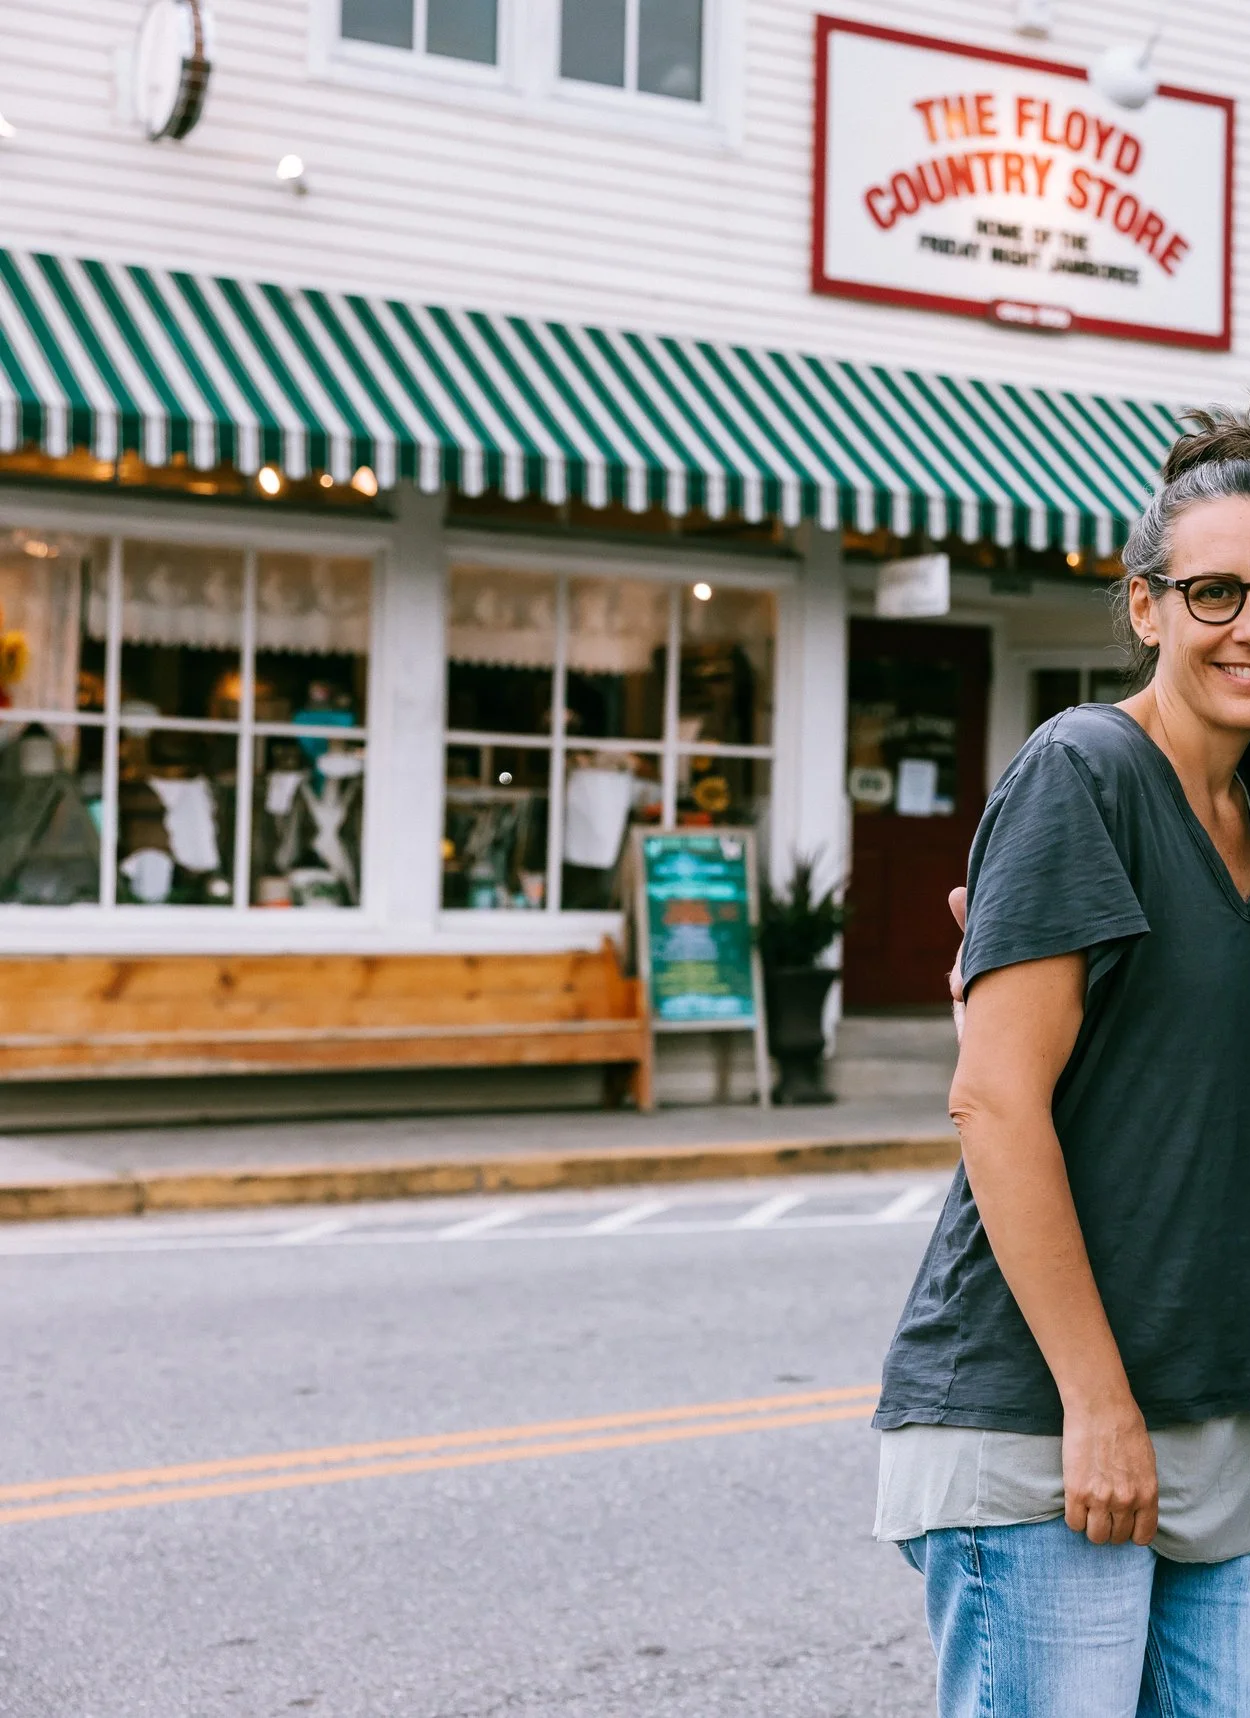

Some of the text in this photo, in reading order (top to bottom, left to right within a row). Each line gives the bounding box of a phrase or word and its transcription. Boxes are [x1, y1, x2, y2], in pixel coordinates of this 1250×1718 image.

[914, 94, 1142, 176] THE FLOYD
[864, 152, 1191, 277] COUNTRY STORE
